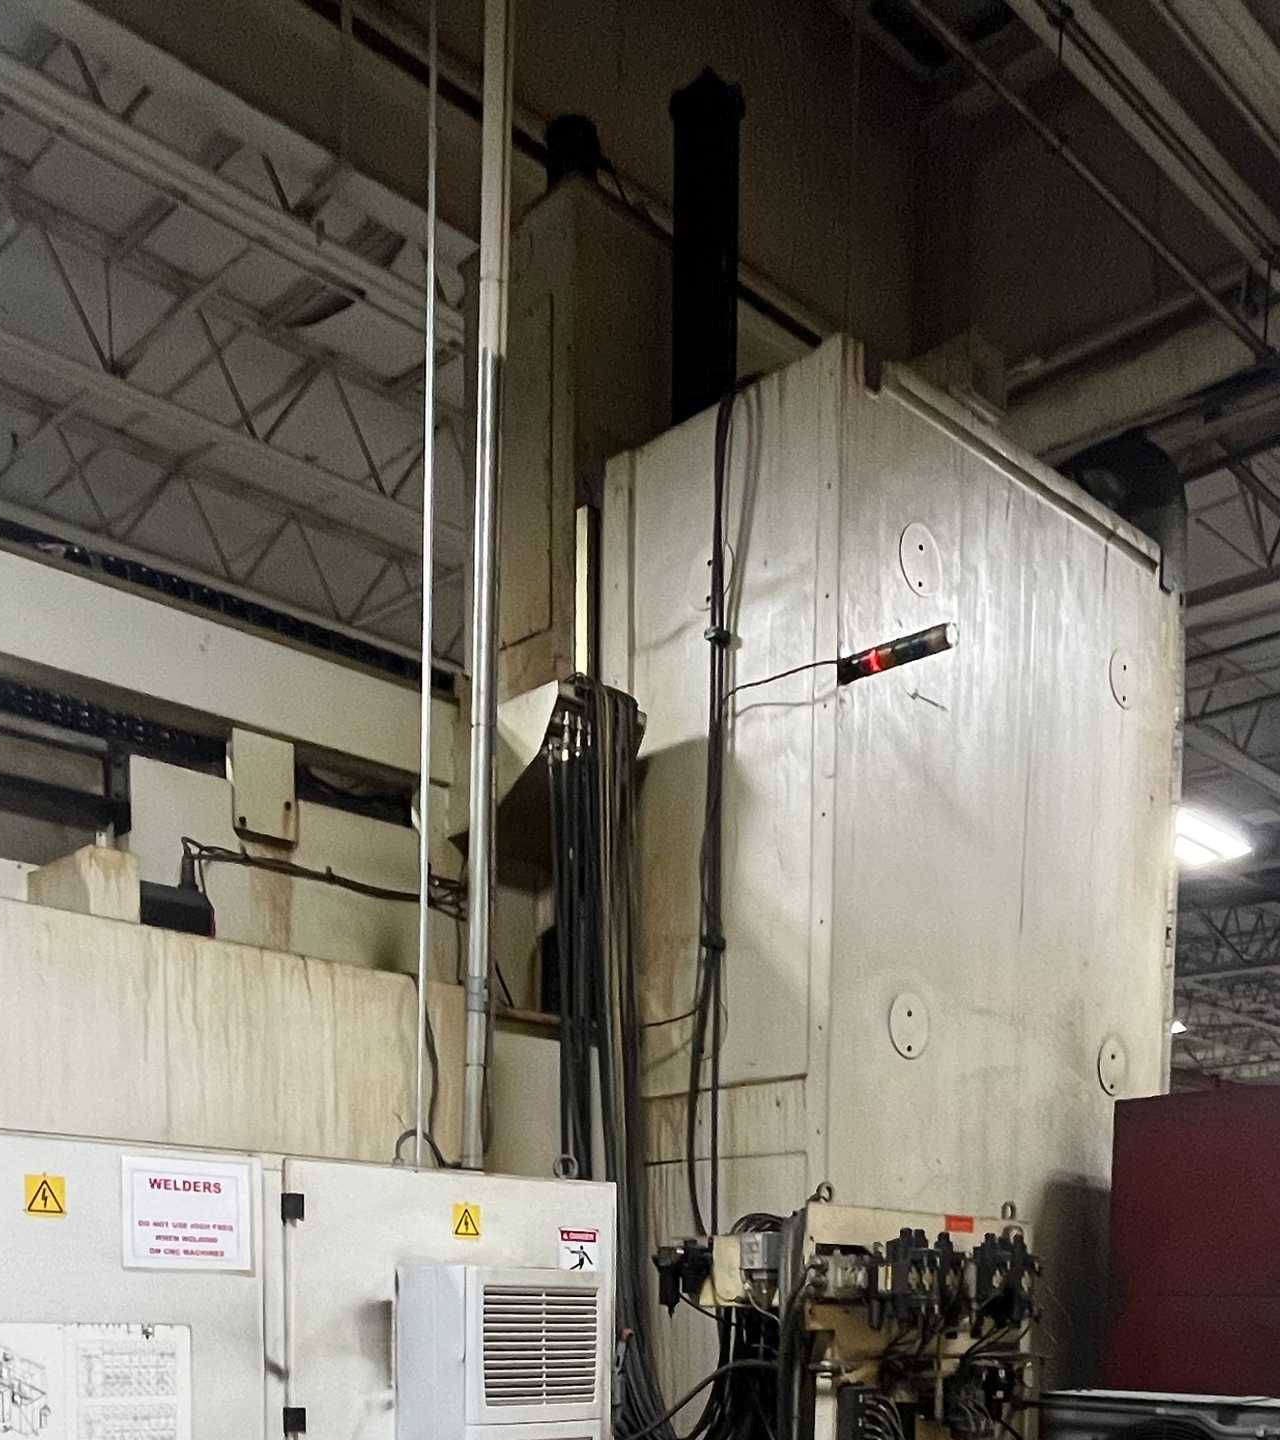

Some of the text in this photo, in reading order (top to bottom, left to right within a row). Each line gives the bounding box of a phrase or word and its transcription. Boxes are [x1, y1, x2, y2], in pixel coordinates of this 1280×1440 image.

[148, 1177, 222, 1195] WELDERS
[138, 1219, 150, 1228] DO
[153, 1220, 169, 1229] NOT
